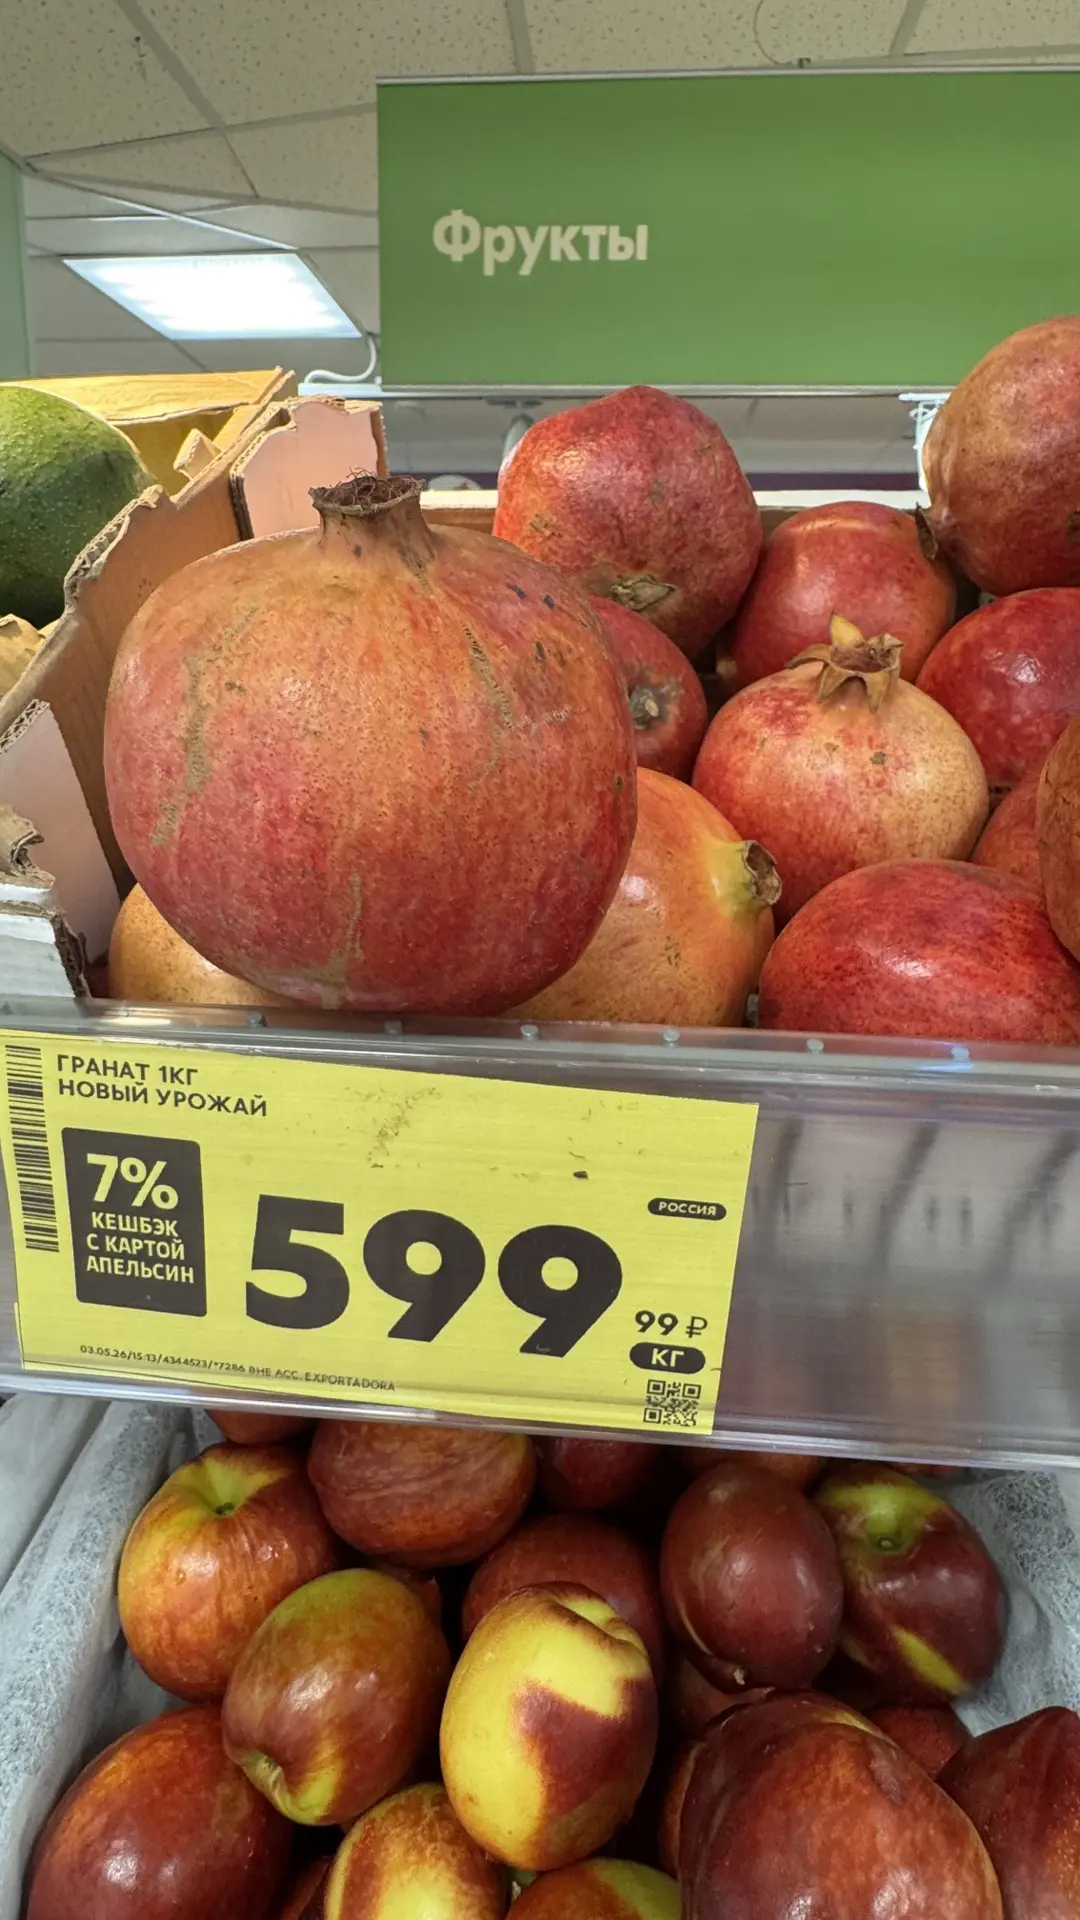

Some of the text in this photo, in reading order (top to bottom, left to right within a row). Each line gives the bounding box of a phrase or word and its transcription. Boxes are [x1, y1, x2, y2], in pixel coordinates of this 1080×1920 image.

[432, 209, 649, 276] Фрукты
[57, 1054, 198, 1085] ГРАНАТ 1КГ
[58, 1078, 267, 1117] НОВЫЙ УРОЖАЙ
[87, 1153, 179, 1210] 7%
[658, 1201, 717, 1216] РОССИЯ
[91, 1211, 179, 1237] КЕШБЭК
[86, 1233, 185, 1260] С КАРТОЙ
[86, 1255, 194, 1284] АПЕЛЬСИН
[245, 1194, 624, 1358] 599
[635, 1310, 678, 1336] 99
[651, 1347, 685, 1367] КГ
[305, 1371, 396, 1392] EXPORTADORA
